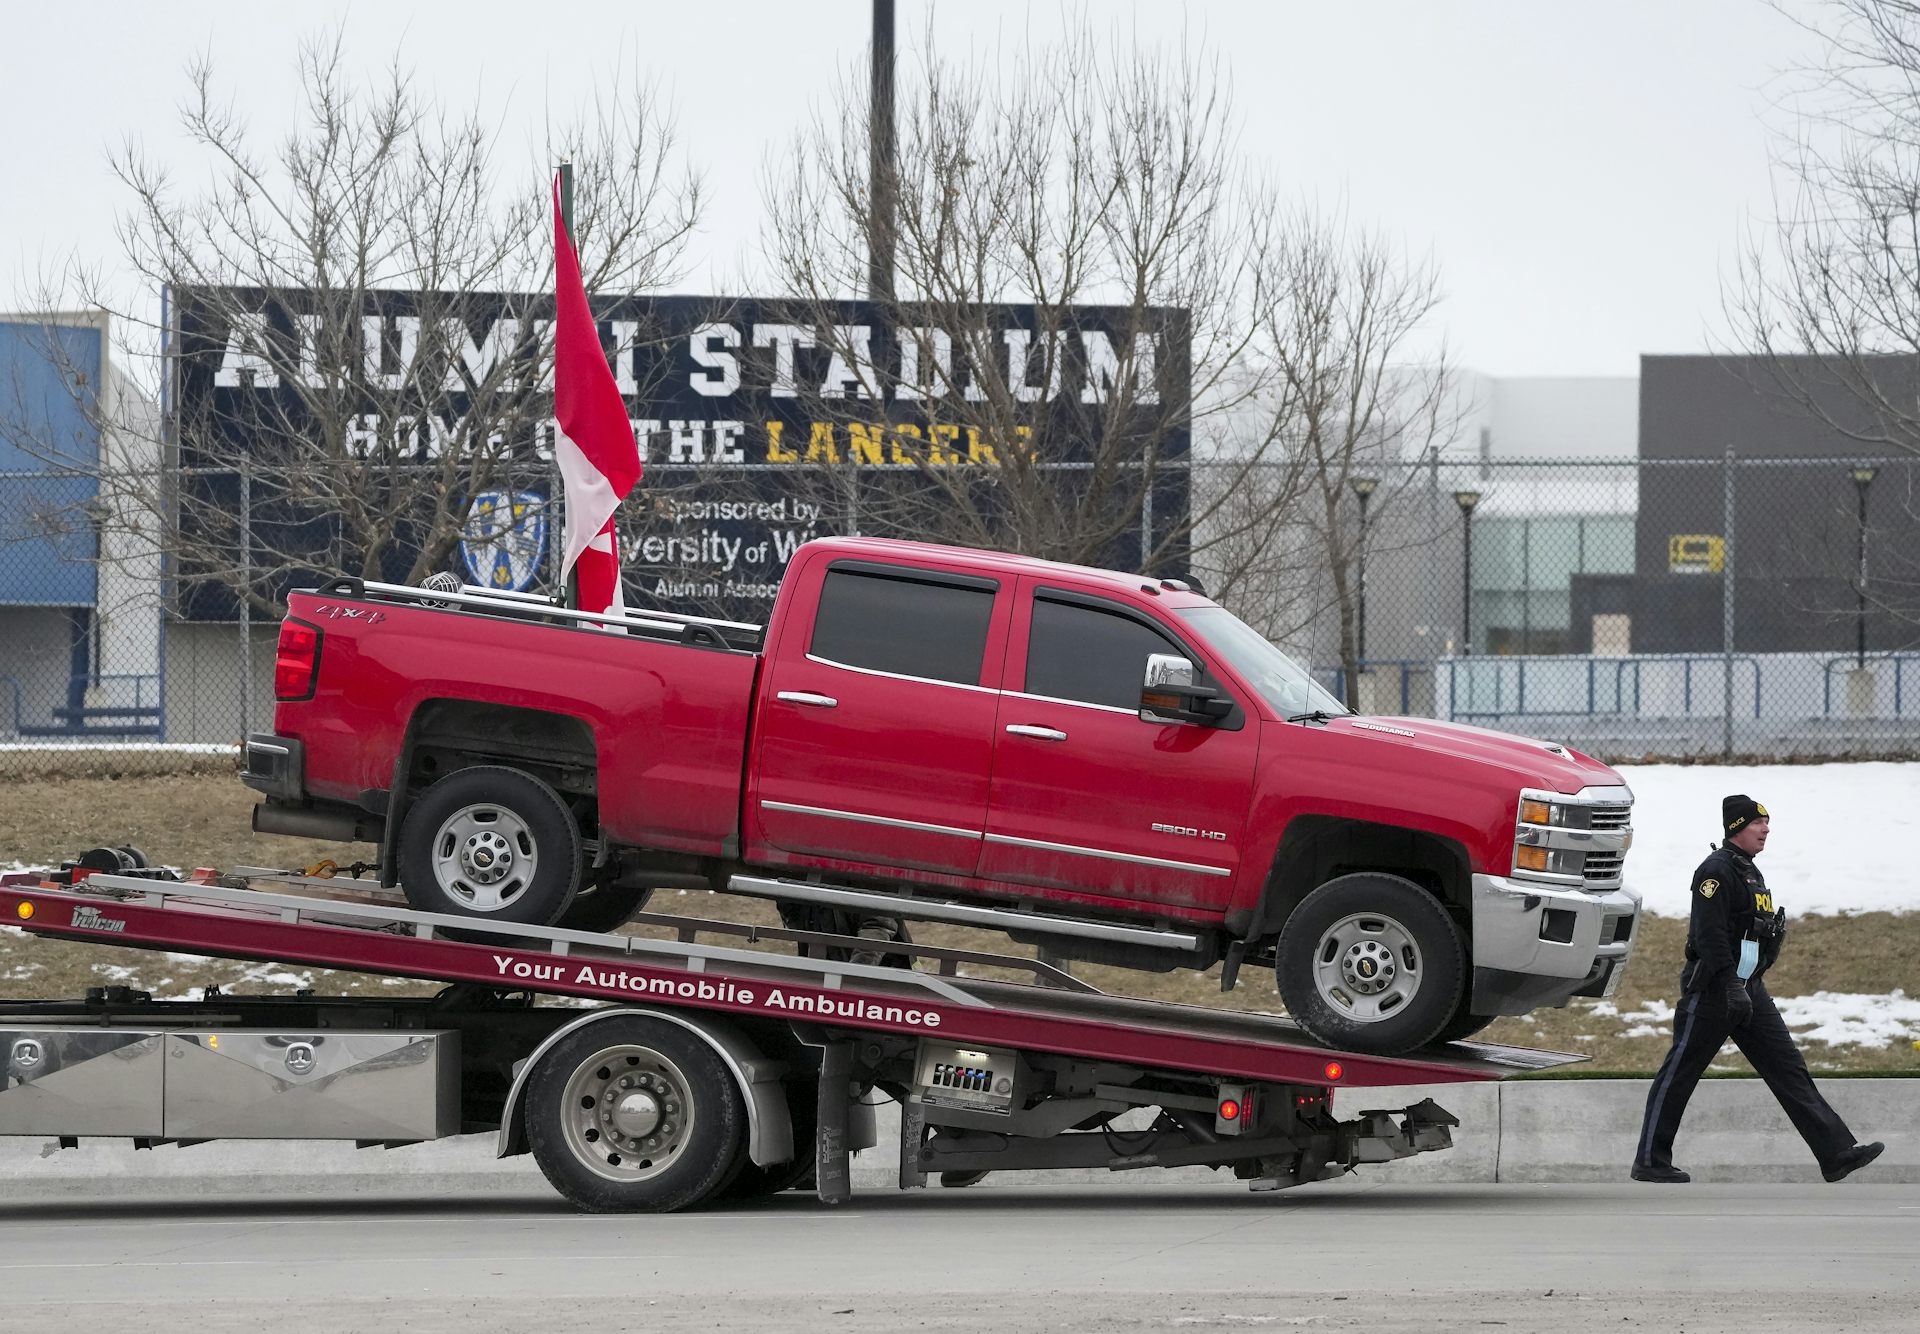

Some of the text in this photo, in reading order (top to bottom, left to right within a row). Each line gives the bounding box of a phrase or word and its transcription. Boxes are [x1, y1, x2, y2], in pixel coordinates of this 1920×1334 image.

[214, 312, 638, 395] ALUMI
[632, 418, 745, 464] THE
[793, 497, 820, 528] by
[561, 526, 742, 572] iversity
[745, 541, 769, 564] of
[1151, 822, 1227, 841] 2500 HD
[1728, 816, 1745, 830] POLICE
[493, 954, 942, 1028] Your Automobile Ambulance
